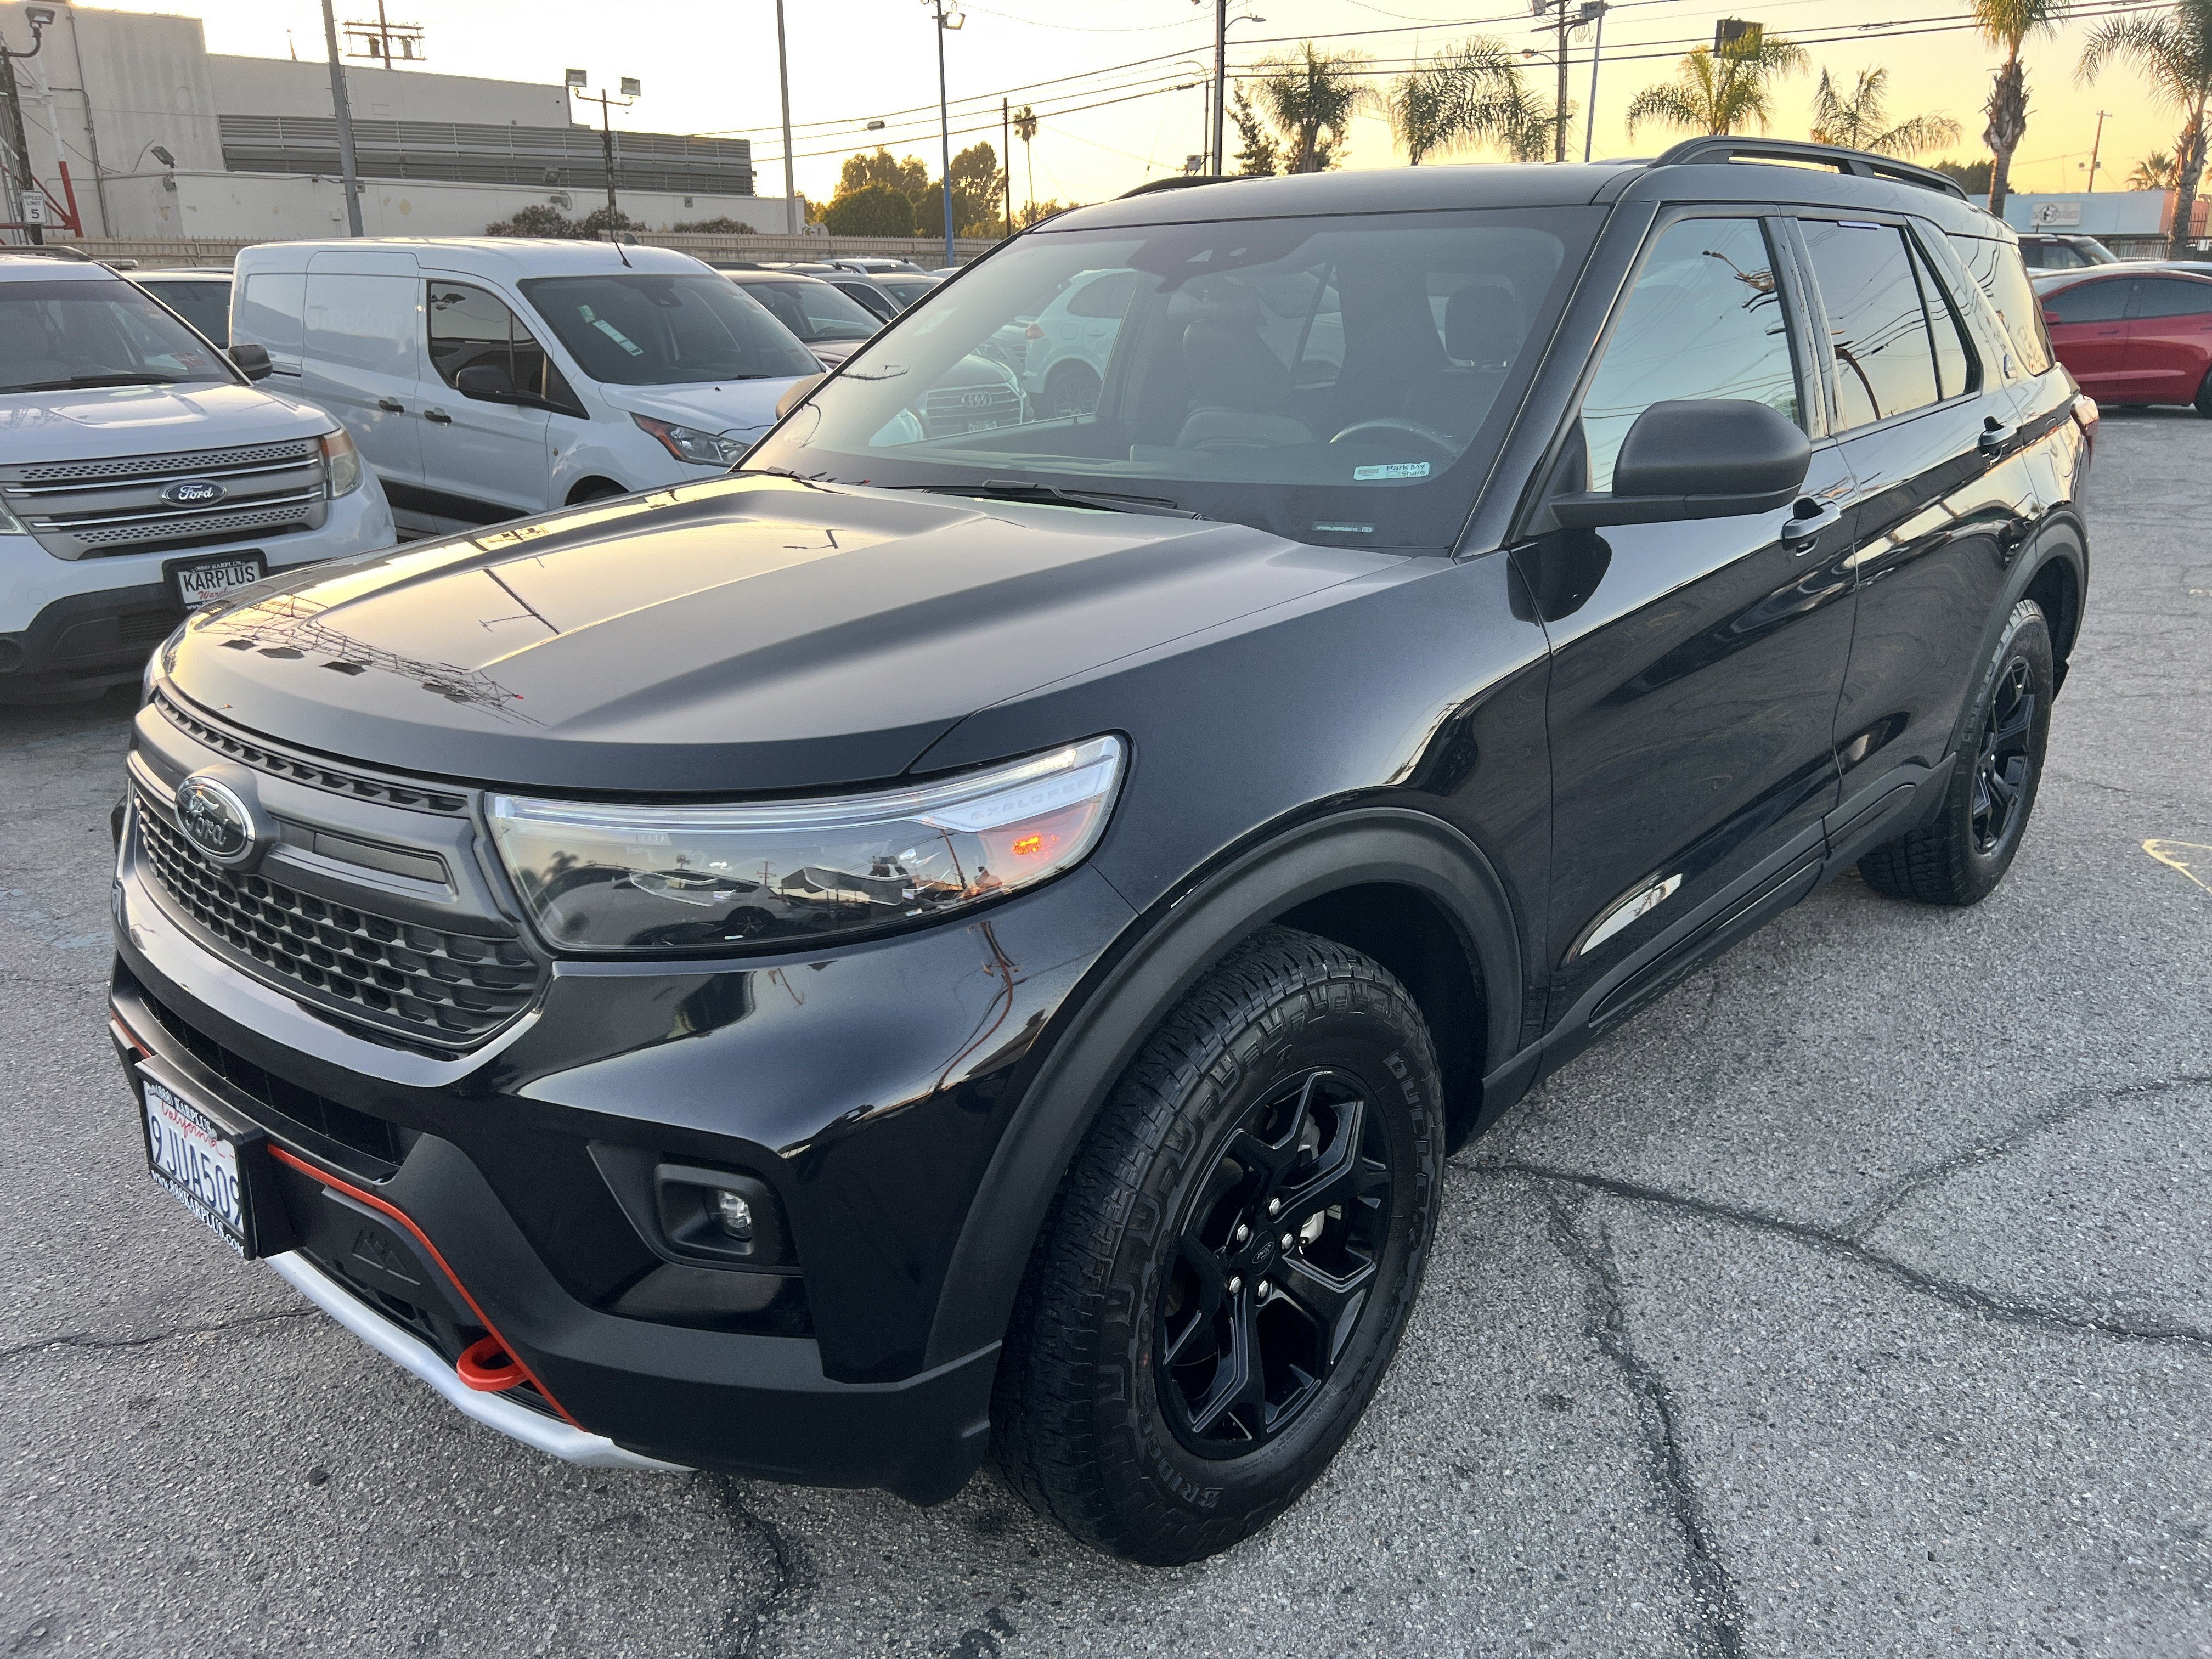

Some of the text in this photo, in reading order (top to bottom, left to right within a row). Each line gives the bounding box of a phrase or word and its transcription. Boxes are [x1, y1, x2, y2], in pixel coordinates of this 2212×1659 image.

[31, 208, 40, 219] 5
[178, 484, 213, 500] Ford
[183, 566, 256, 592] KARPLUS
[212, 560, 242, 569] KARPLUS
[970, 778, 1091, 822] EXPLORER
[185, 793, 229, 847] Ford
[161, 1100, 226, 1158] California
[174, 1096, 213, 1133] KARPLUS
